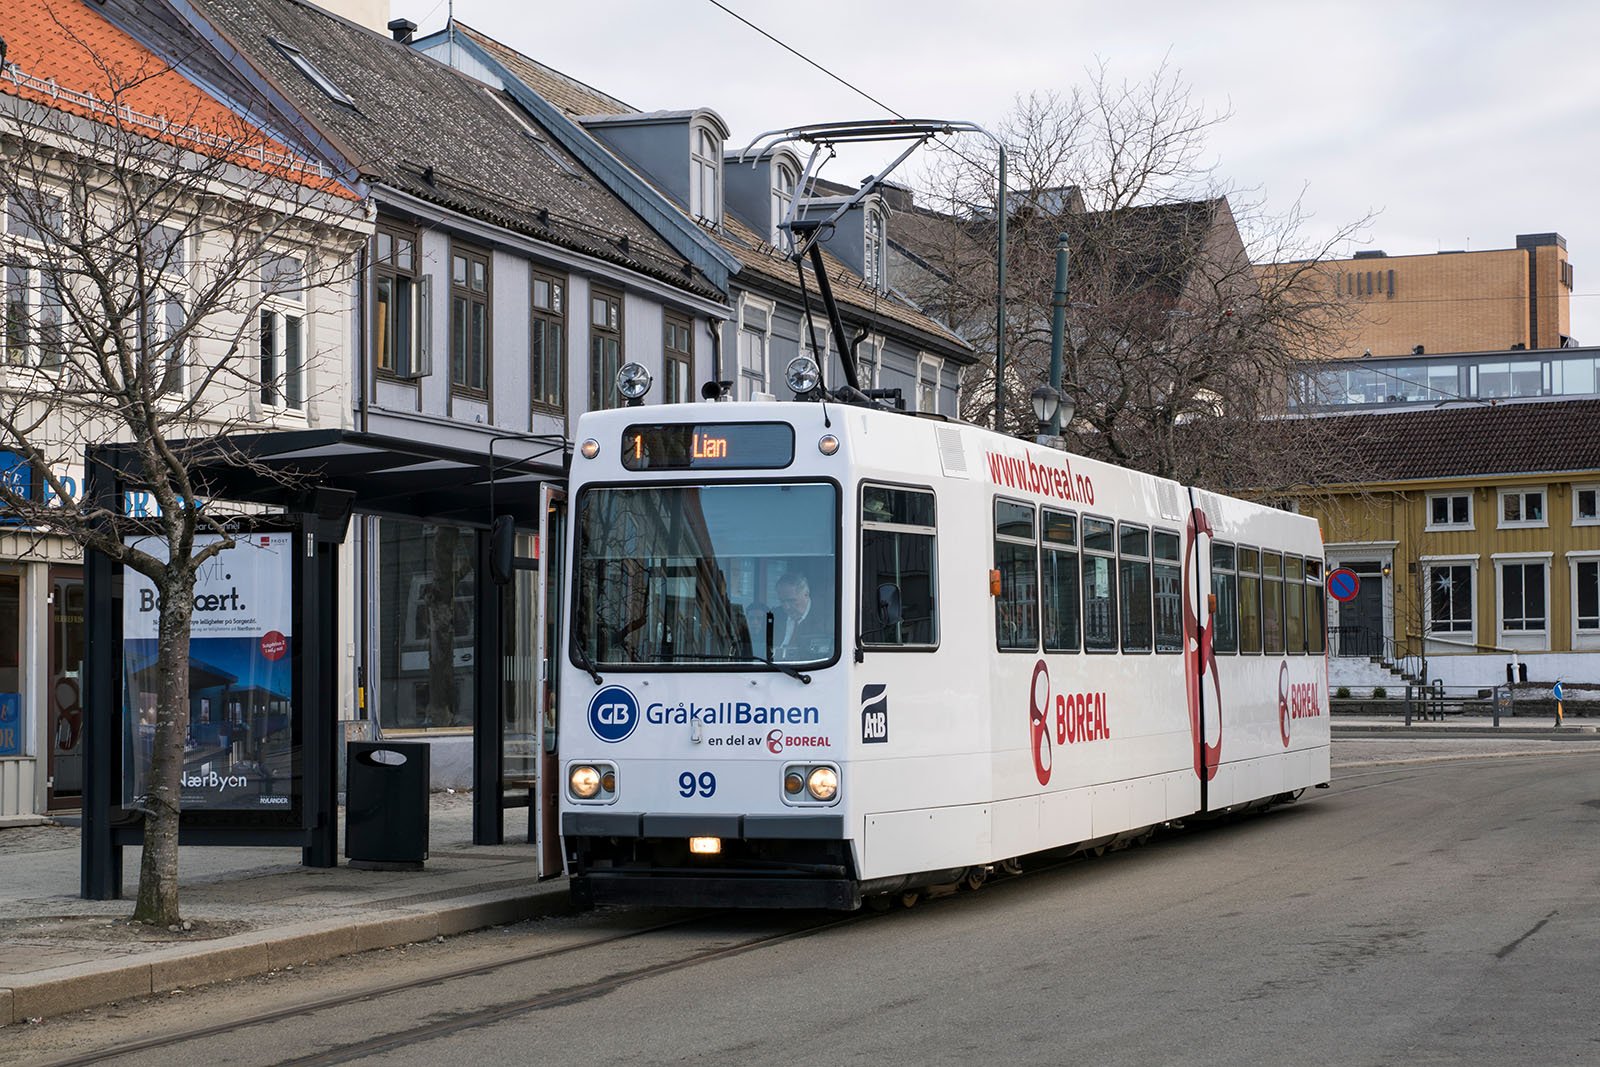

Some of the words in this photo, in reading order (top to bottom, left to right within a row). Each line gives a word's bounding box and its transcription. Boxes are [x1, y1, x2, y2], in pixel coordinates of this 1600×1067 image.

[633, 434, 644, 459] 1
[692, 433, 728, 459] Lian
[986, 447, 1095, 506] www.boreal.no
[192, 586, 246, 613] ært.
[646, 702, 819, 724] GråkallBanen
[1291, 681, 1321, 720] BOREAL
[596, 703, 630, 725] GB
[864, 712, 886, 739] AtB
[1056, 691, 1111, 746] BOREAL
[708, 737, 723, 746] en
[726, 735, 745, 746] del
[747, 737, 762, 746] av
[785, 736, 831, 747] BOREAL
[679, 772, 717, 798] 99
